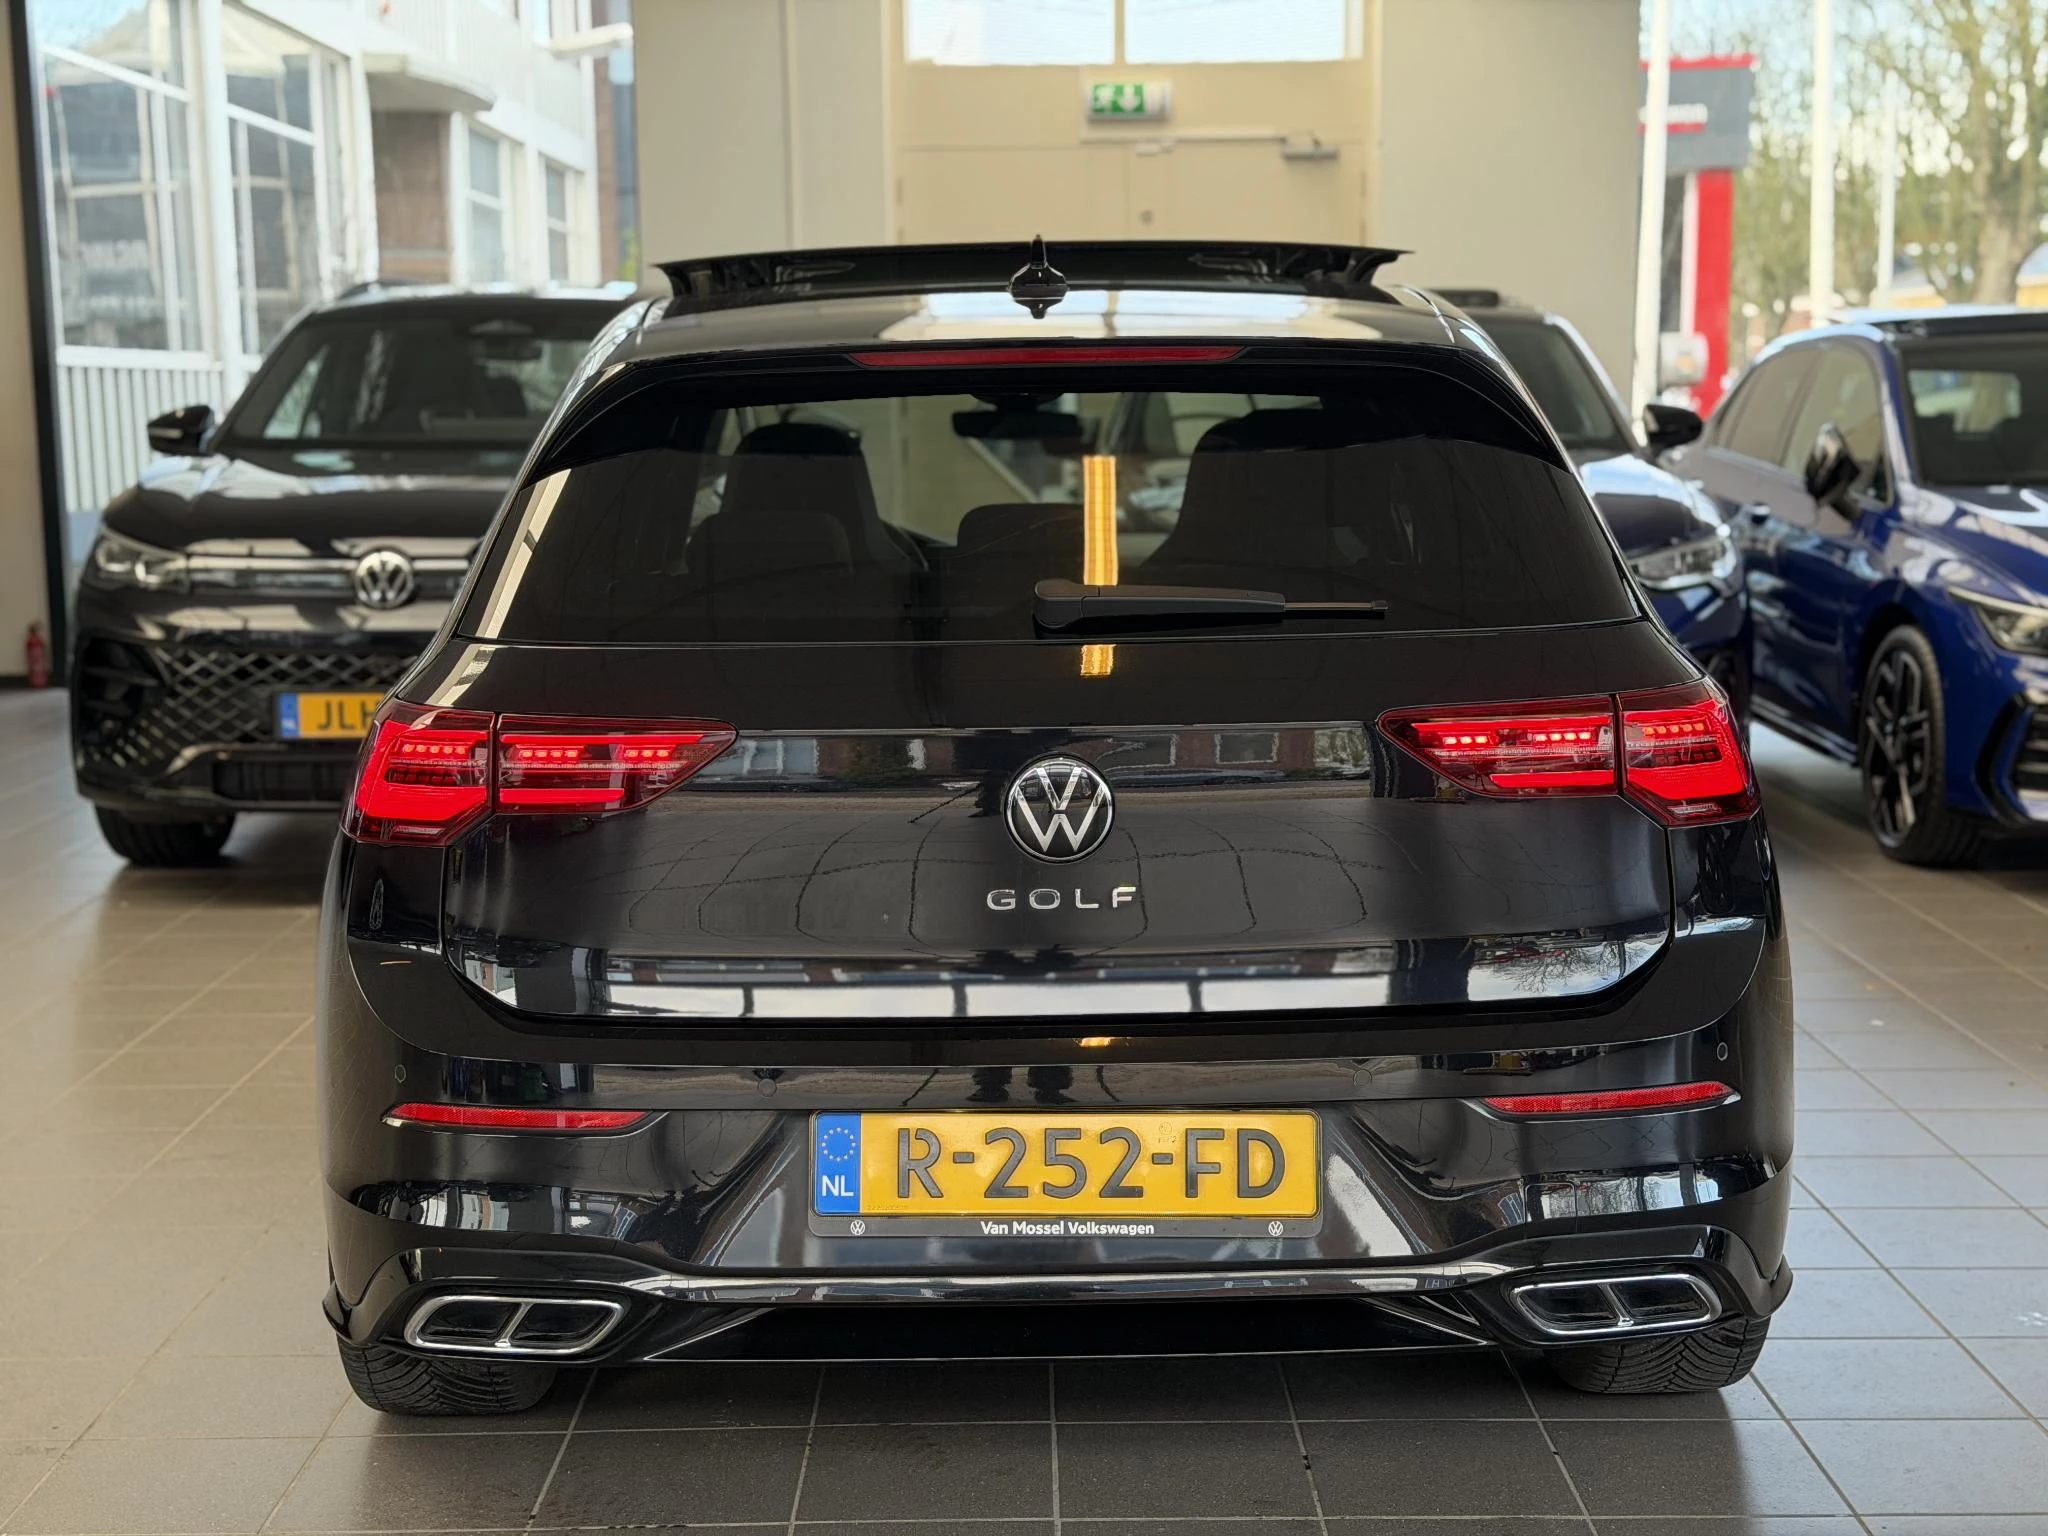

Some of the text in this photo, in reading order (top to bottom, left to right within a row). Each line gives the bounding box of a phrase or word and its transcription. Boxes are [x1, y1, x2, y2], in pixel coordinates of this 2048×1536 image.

[986, 885, 1137, 911] GOLF
[897, 1126, 1286, 1199] R-252-FD
[820, 1175, 854, 1197] NL
[980, 1220, 1155, 1236] Van Mossel Volkswagen
